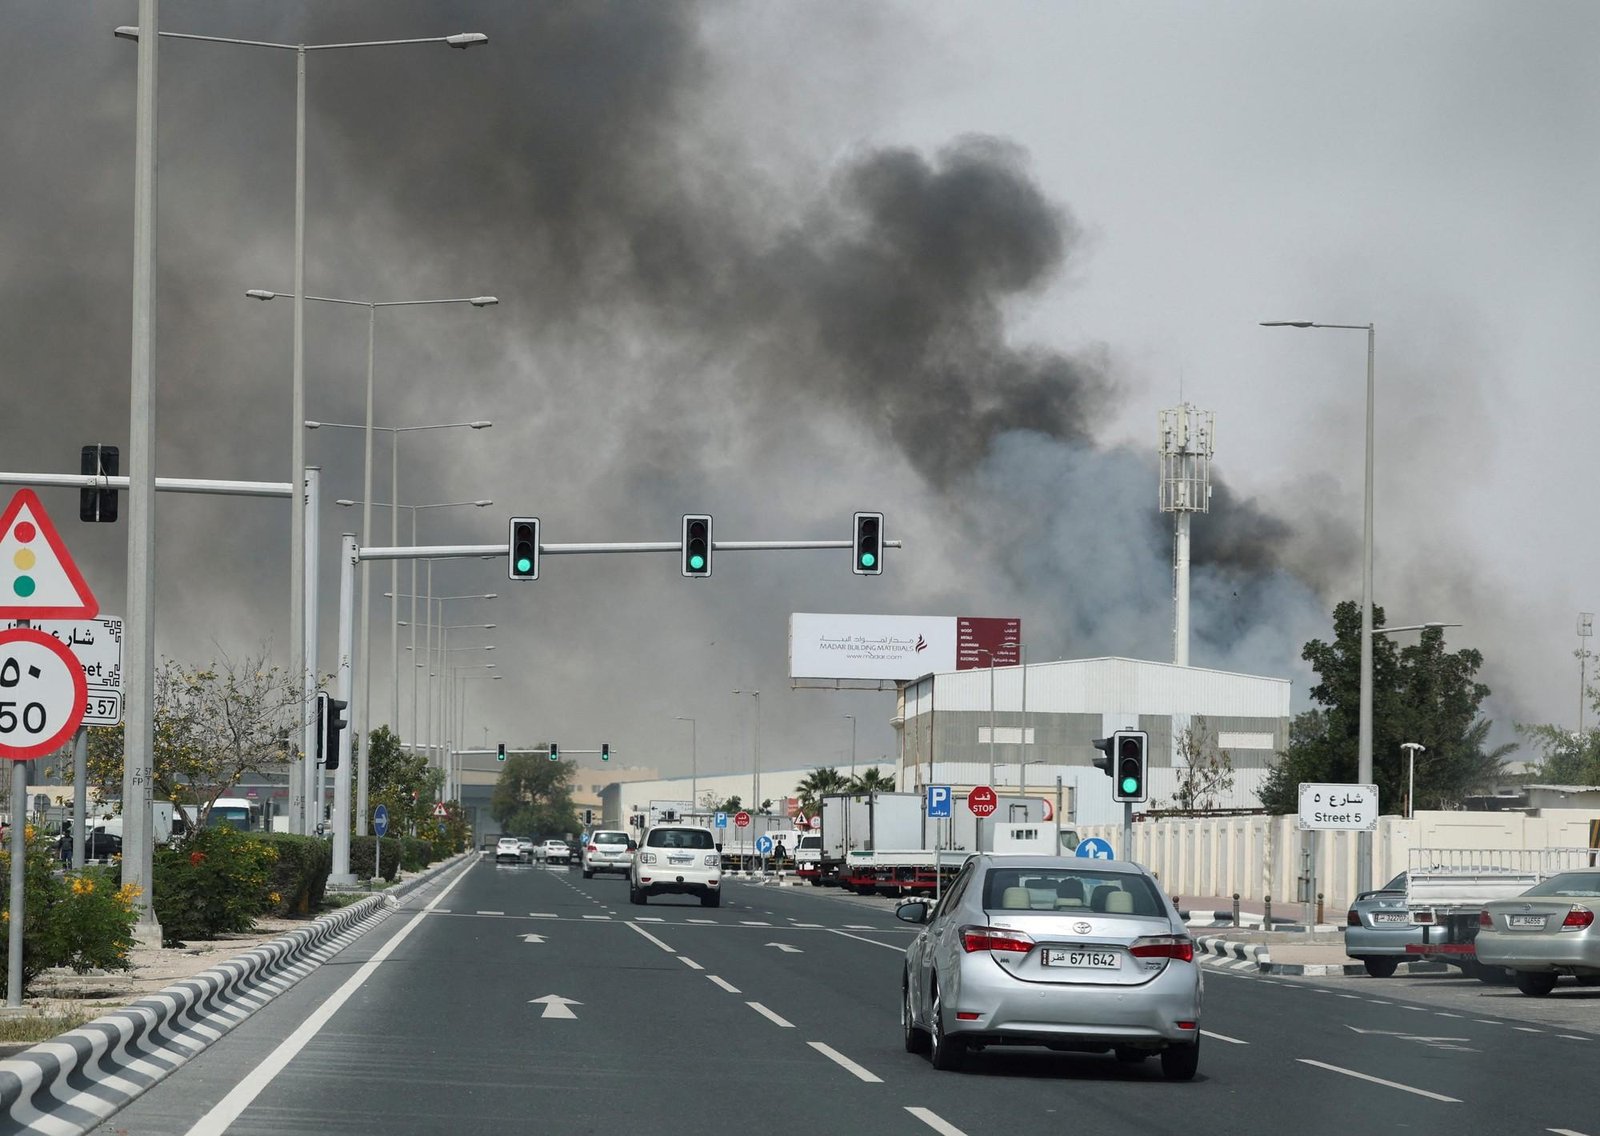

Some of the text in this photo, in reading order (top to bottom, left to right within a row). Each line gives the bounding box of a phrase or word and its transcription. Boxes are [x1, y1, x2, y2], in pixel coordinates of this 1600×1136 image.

[97, 700, 116, 716] 57
[0, 702, 46, 734] 50
[932, 788, 947, 807] P
[974, 792, 991, 800] قف
[1330, 793, 1363, 807] شارع
[973, 805, 994, 813] STOP
[1314, 812, 1362, 822] Street 5
[1070, 953, 1115, 966] 671642
